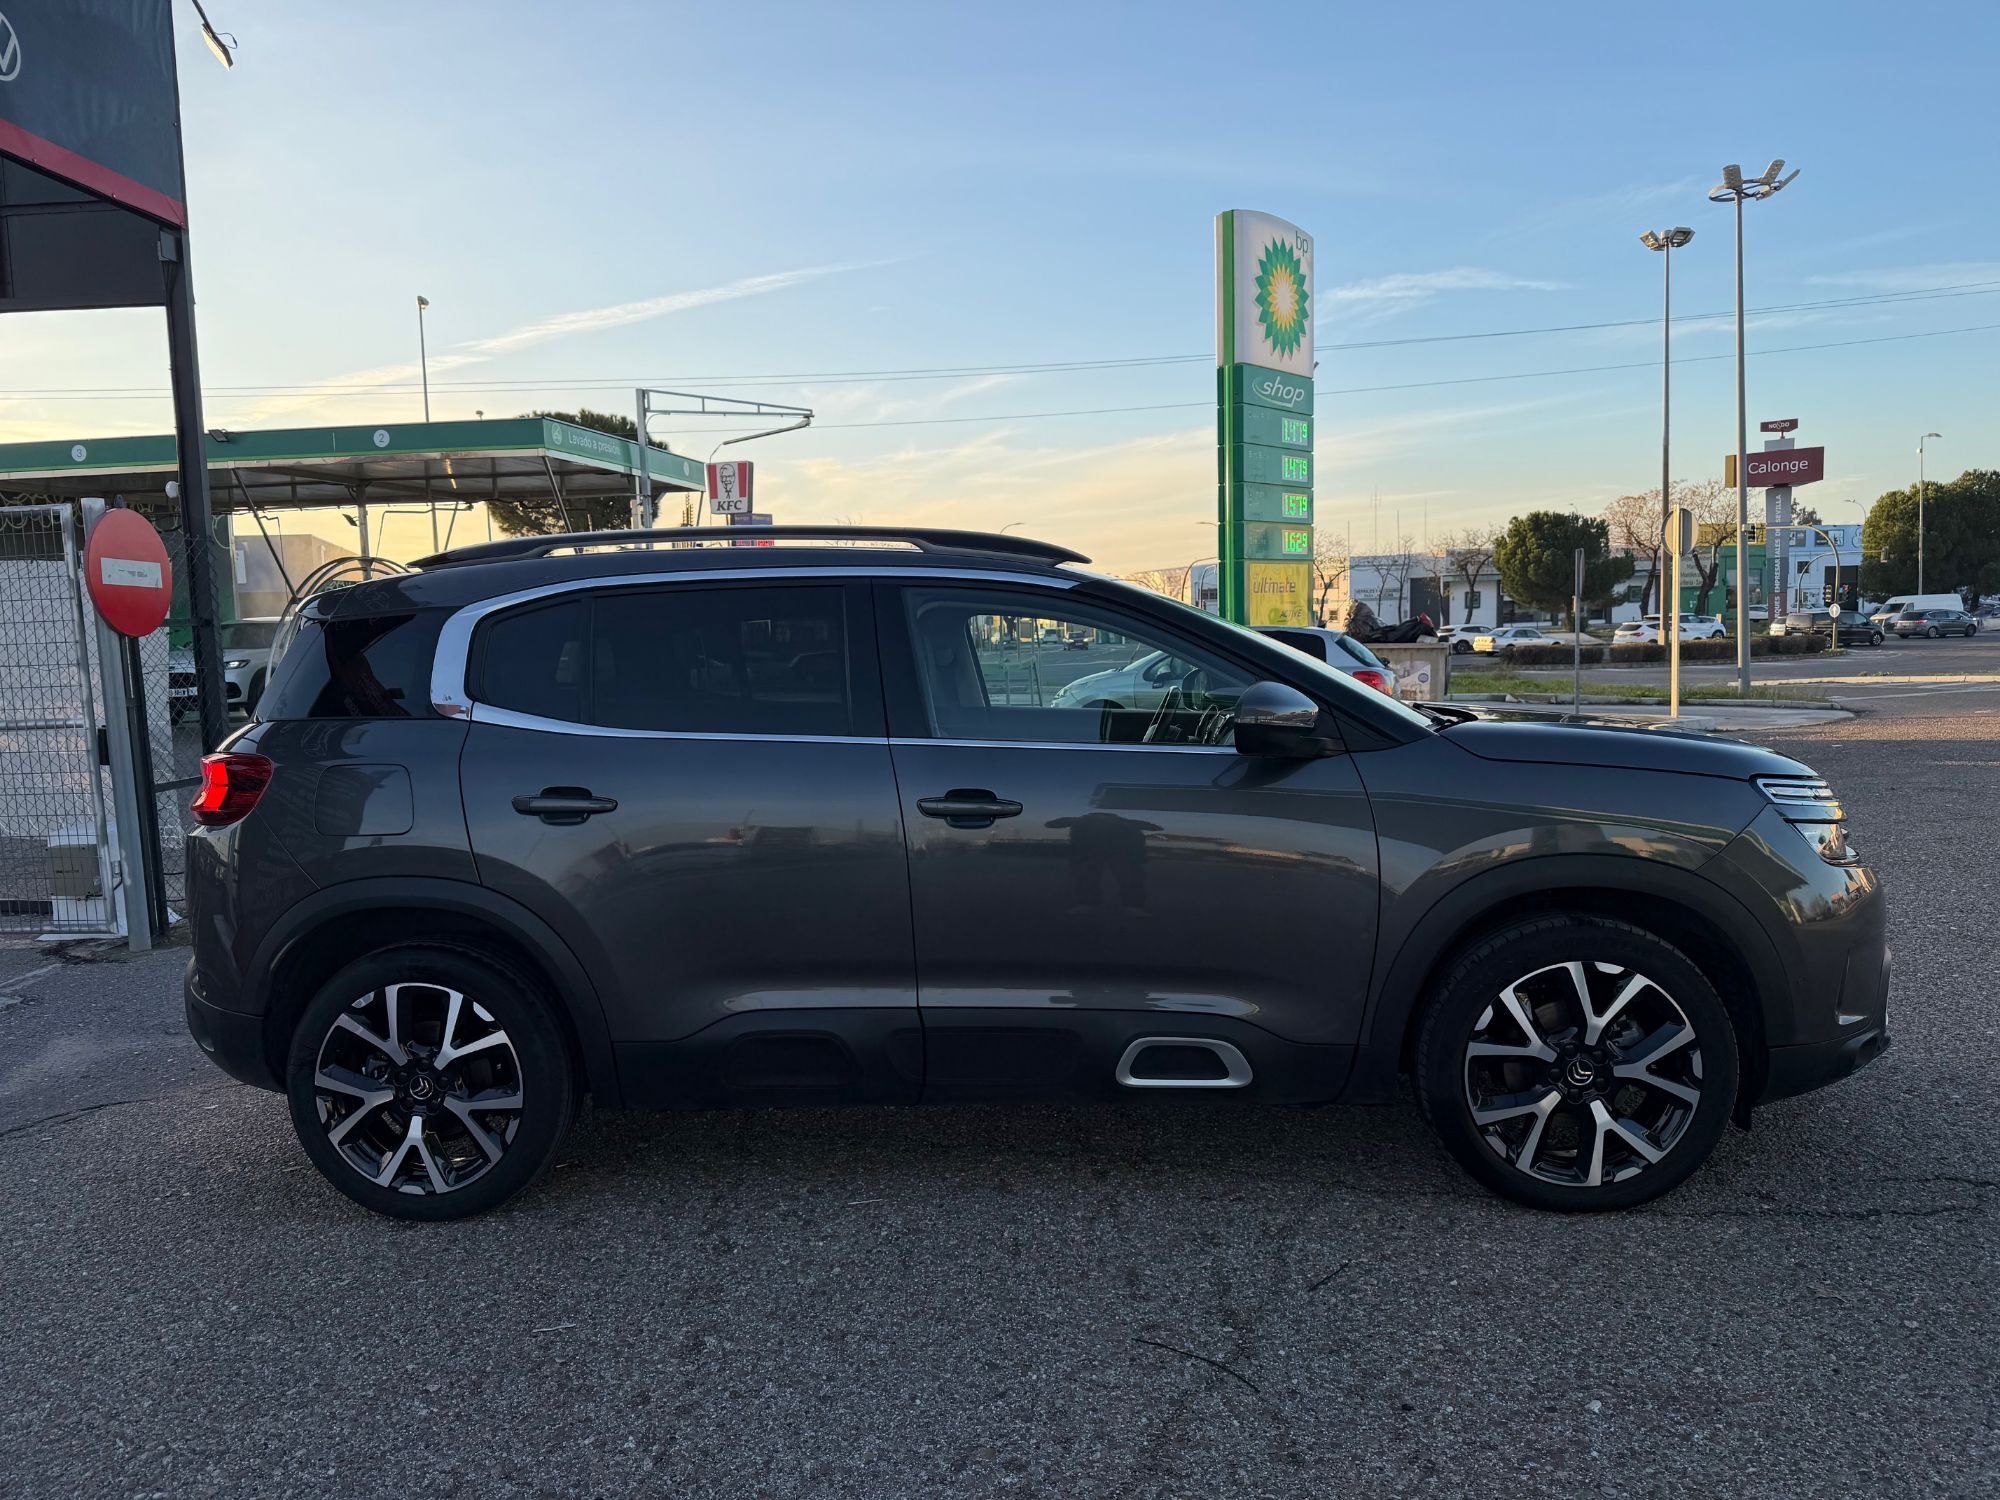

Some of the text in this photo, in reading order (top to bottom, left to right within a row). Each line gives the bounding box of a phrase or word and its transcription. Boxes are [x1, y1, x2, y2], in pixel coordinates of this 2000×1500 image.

[1295, 230, 1309, 257] bp
[1263, 376, 1305, 407] shop
[377, 433, 386, 444] 2
[568, 431, 621, 456] Lavado a presión
[75, 447, 83, 459] 3
[1748, 460, 1809, 474] Calonge
[716, 499, 743, 512] KFC
[1253, 576, 1296, 594] ultimate
[1279, 608, 1303, 618] ACTIVE
